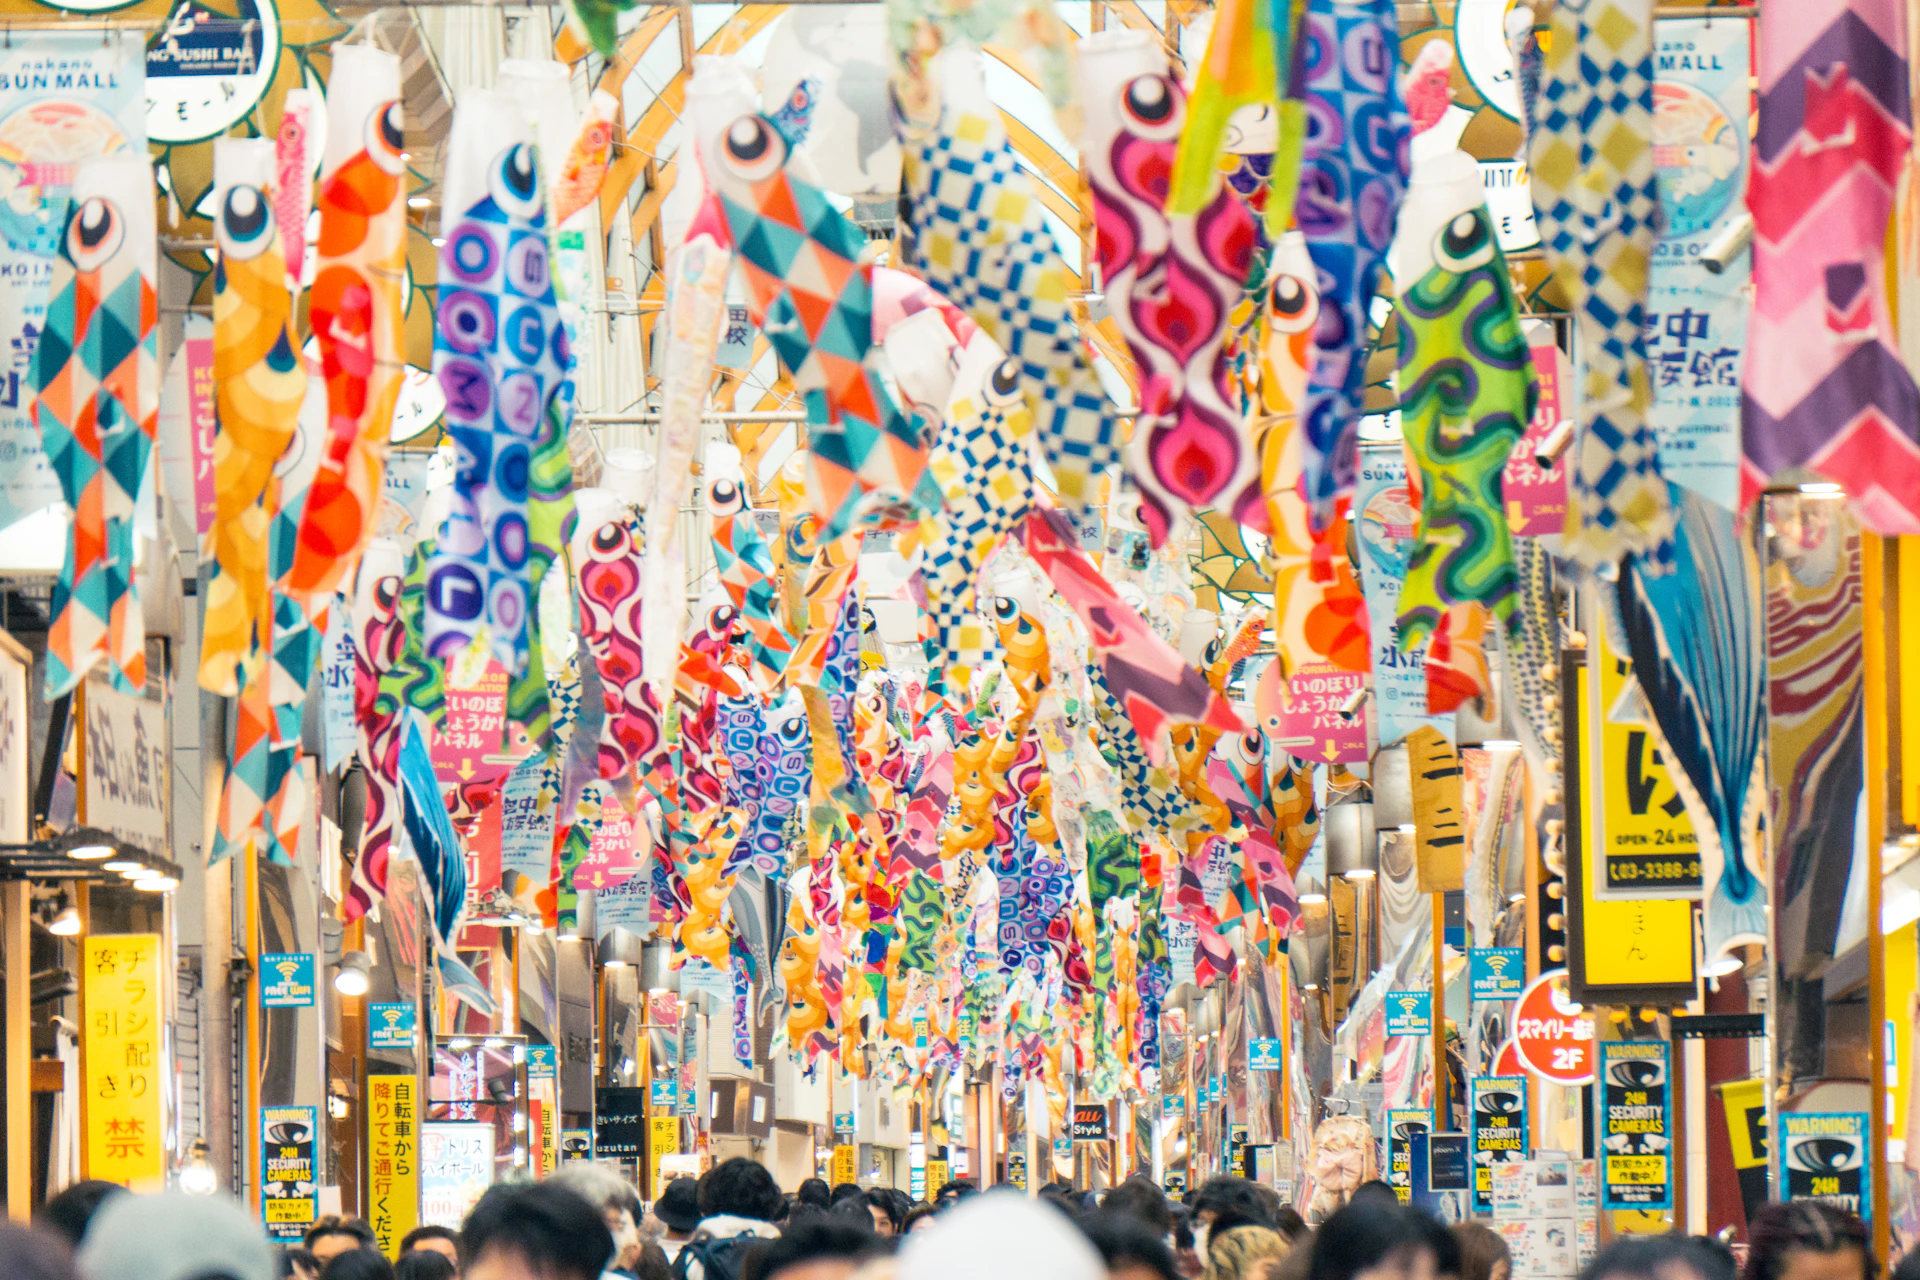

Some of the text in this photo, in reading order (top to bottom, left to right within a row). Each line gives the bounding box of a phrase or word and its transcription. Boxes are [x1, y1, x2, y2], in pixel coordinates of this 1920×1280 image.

[56, 74, 118, 88] MALL
[1363, 470, 1394, 481] SUN
[433, 732, 483, 749] パネル
[94, 949, 118, 1099] 客引き
[123, 950, 150, 1098] チラシ配り
[1606, 1044, 1664, 1059] WARNING!
[1552, 1047, 1584, 1070] 2F
[1476, 1079, 1521, 1091] WARNING!
[1625, 1092, 1647, 1105] 24H
[264, 1108, 313, 1121] WARNING!
[1075, 1110, 1103, 1123] au
[1609, 1106, 1663, 1120] SECURITY
[1490, 1117, 1508, 1128] 24H
[1609, 1119, 1663, 1134] CAMERAS
[1785, 1117, 1861, 1135] WARNING!
[394, 1083, 412, 1176] 自転車から
[1074, 1124, 1102, 1136] Style
[1478, 1127, 1521, 1140] SECURITY
[1478, 1139, 1521, 1150] CAMERAS
[281, 1146, 298, 1159] 24H
[267, 1158, 311, 1170] SECURITY
[267, 1169, 312, 1182] CAMERAS
[1810, 1177, 1840, 1196] 24H
